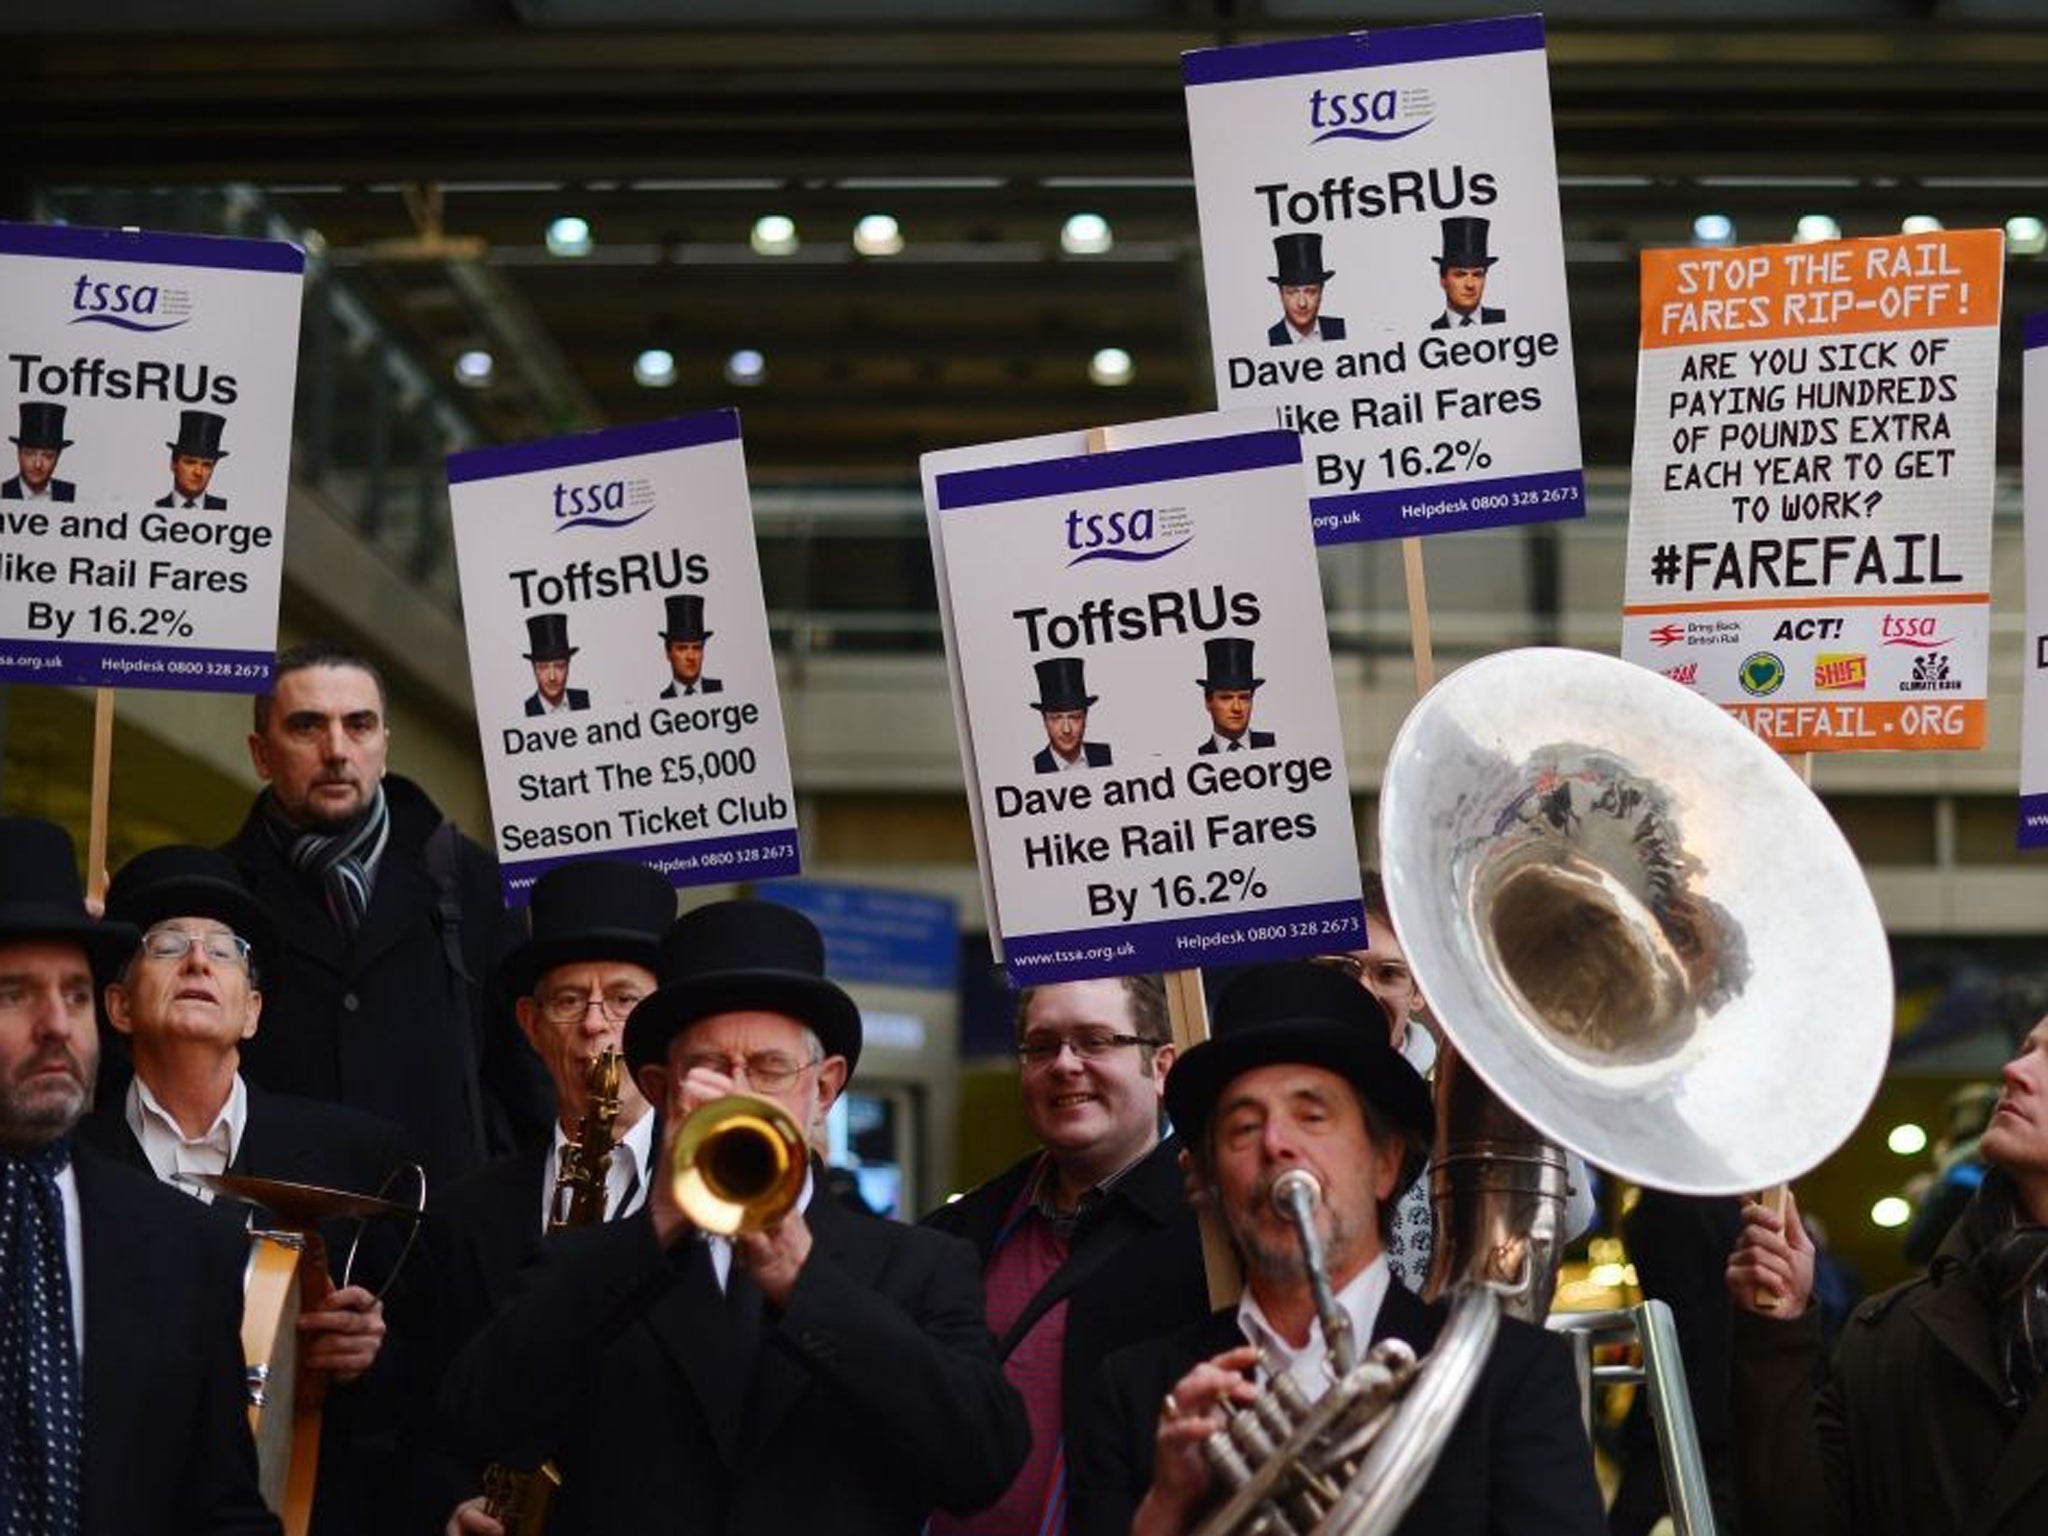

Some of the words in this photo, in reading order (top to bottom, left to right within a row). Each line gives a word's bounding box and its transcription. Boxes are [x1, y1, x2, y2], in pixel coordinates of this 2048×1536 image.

[1309, 89, 1397, 128] tssa
[1255, 166, 1498, 227] ToffsRUs
[1677, 257, 1770, 295] STOP
[1784, 251, 1853, 286] THE
[1866, 244, 1962, 280] RAIL
[74, 274, 158, 314] tssa
[1661, 296, 1770, 335] FARES
[1784, 282, 1969, 326] RIP-OFF!
[9, 354, 238, 404] ToffsRUs
[1229, 355, 1324, 389] Dave
[1335, 342, 1407, 379] and
[1418, 331, 1559, 369] George
[1681, 352, 1738, 382] ARE
[1749, 348, 1807, 376] YOU
[1819, 341, 1898, 372] SICK
[1910, 338, 1949, 366] OF
[1277, 405, 1340, 435] ike
[1352, 393, 1423, 430] Rail
[1436, 385, 1542, 420] Fares
[1670, 385, 1786, 418] PAYING
[1796, 375, 1958, 410] HUNDREDS
[1672, 426, 1709, 454] OF
[1720, 418, 1839, 451] POUNDS
[1850, 412, 1951, 443] EXTRA
[1316, 454, 1366, 491] By
[1379, 438, 1491, 479] 16.2%
[1664, 460, 1742, 491] EACH
[1754, 455, 1832, 485] YEAR
[1844, 453, 1883, 480] TO
[1895, 449, 1955, 479] GET
[553, 481, 624, 517] tssa
[1401, 499, 1469, 519] Helpdesk
[1471, 494, 1509, 511] 0800
[1511, 490, 1539, 507] 328
[1542, 486, 1578, 502] 2673
[1732, 496, 1770, 523] TO
[1782, 490, 1883, 522] WORK?
[60, 512, 128, 540] and
[141, 514, 272, 554] George
[1065, 509, 1153, 549] tssa
[0, 553, 57, 583] ike
[69, 557, 136, 588] Rail
[149, 561, 248, 594] Fares
[510, 548, 709, 609] ToffsRUs
[1651, 533, 1963, 591] #FAREFAIL
[28, 602, 75, 638] By
[88, 605, 194, 637] 16.2%
[1013, 585, 1261, 652] ToffsRUs
[1773, 618, 1844, 642] ACT!
[1883, 614, 1936, 638] tssa
[101, 658, 164, 674] Helpdesk
[168, 663, 203, 675] 0800
[205, 664, 232, 676] 328
[234, 665, 269, 678] 2673
[503, 723, 577, 755] Dave
[587, 714, 641, 745] and
[649, 701, 760, 738] George
[1728, 704, 1965, 738] AREFAIL.ORG
[519, 771, 587, 802] Start
[596, 763, 652, 792] The
[661, 747, 757, 784] £5,000
[995, 783, 1091, 818] Dave
[1103, 768, 1174, 806] and
[1187, 755, 1333, 798] George
[502, 821, 612, 852] Season
[619, 804, 708, 839] Ticket
[718, 793, 787, 824] Club
[1025, 832, 1110, 869] Hike
[1122, 821, 1194, 859] Rail
[1207, 811, 1317, 850] Fares
[645, 856, 699, 876] elpdesk
[701, 853, 734, 867] 0800
[736, 850, 760, 862] 328
[762, 845, 794, 860] 2673
[1087, 883, 1139, 921] By
[1151, 866, 1268, 911] 16.2%
[1014, 942, 1136, 966] www.tssa.org.uk
[1177, 930, 1245, 950] Helpdesk
[1248, 925, 1286, 942] 0800
[1290, 921, 1318, 938] 328
[1321, 917, 1359, 934] 2673
